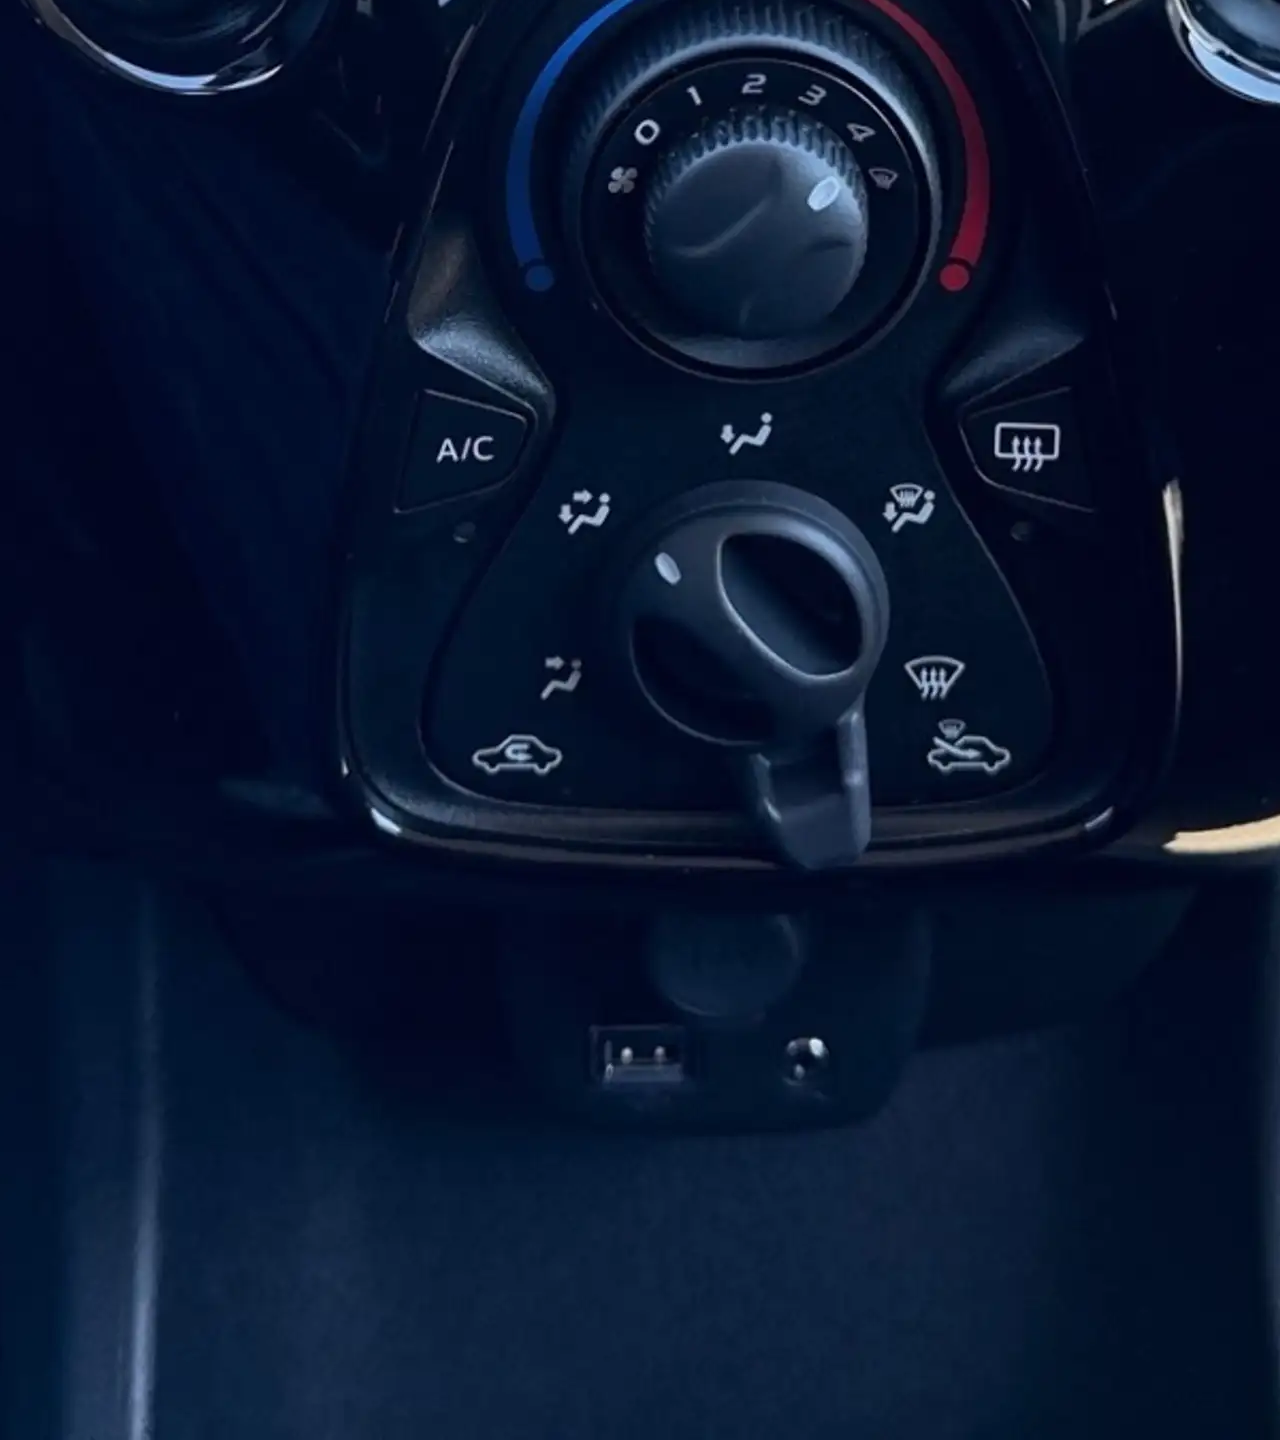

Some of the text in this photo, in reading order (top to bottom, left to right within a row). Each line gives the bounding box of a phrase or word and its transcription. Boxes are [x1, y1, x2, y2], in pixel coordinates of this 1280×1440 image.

[634, 73, 877, 145] 0 1 2 3 4
[435, 435, 495, 464] A/C
